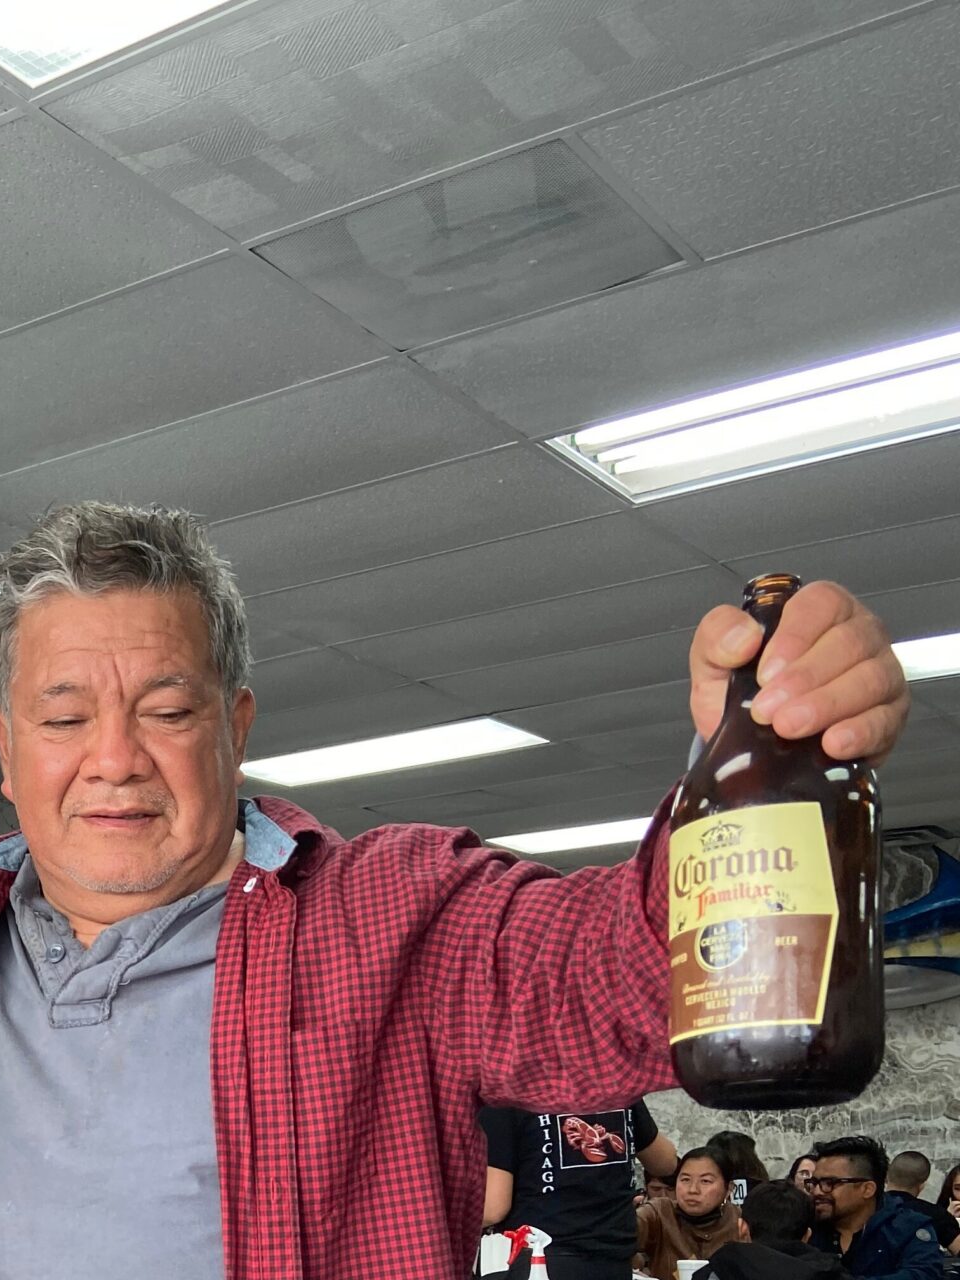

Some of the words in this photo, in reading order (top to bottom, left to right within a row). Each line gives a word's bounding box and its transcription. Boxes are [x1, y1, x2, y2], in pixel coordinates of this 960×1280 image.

[674, 846, 795, 900] Corona
[696, 883, 774, 920] Familiar
[713, 926, 727, 935] LA
[775, 935, 798, 947] BEER
[733, 1183, 744, 1200] 20
